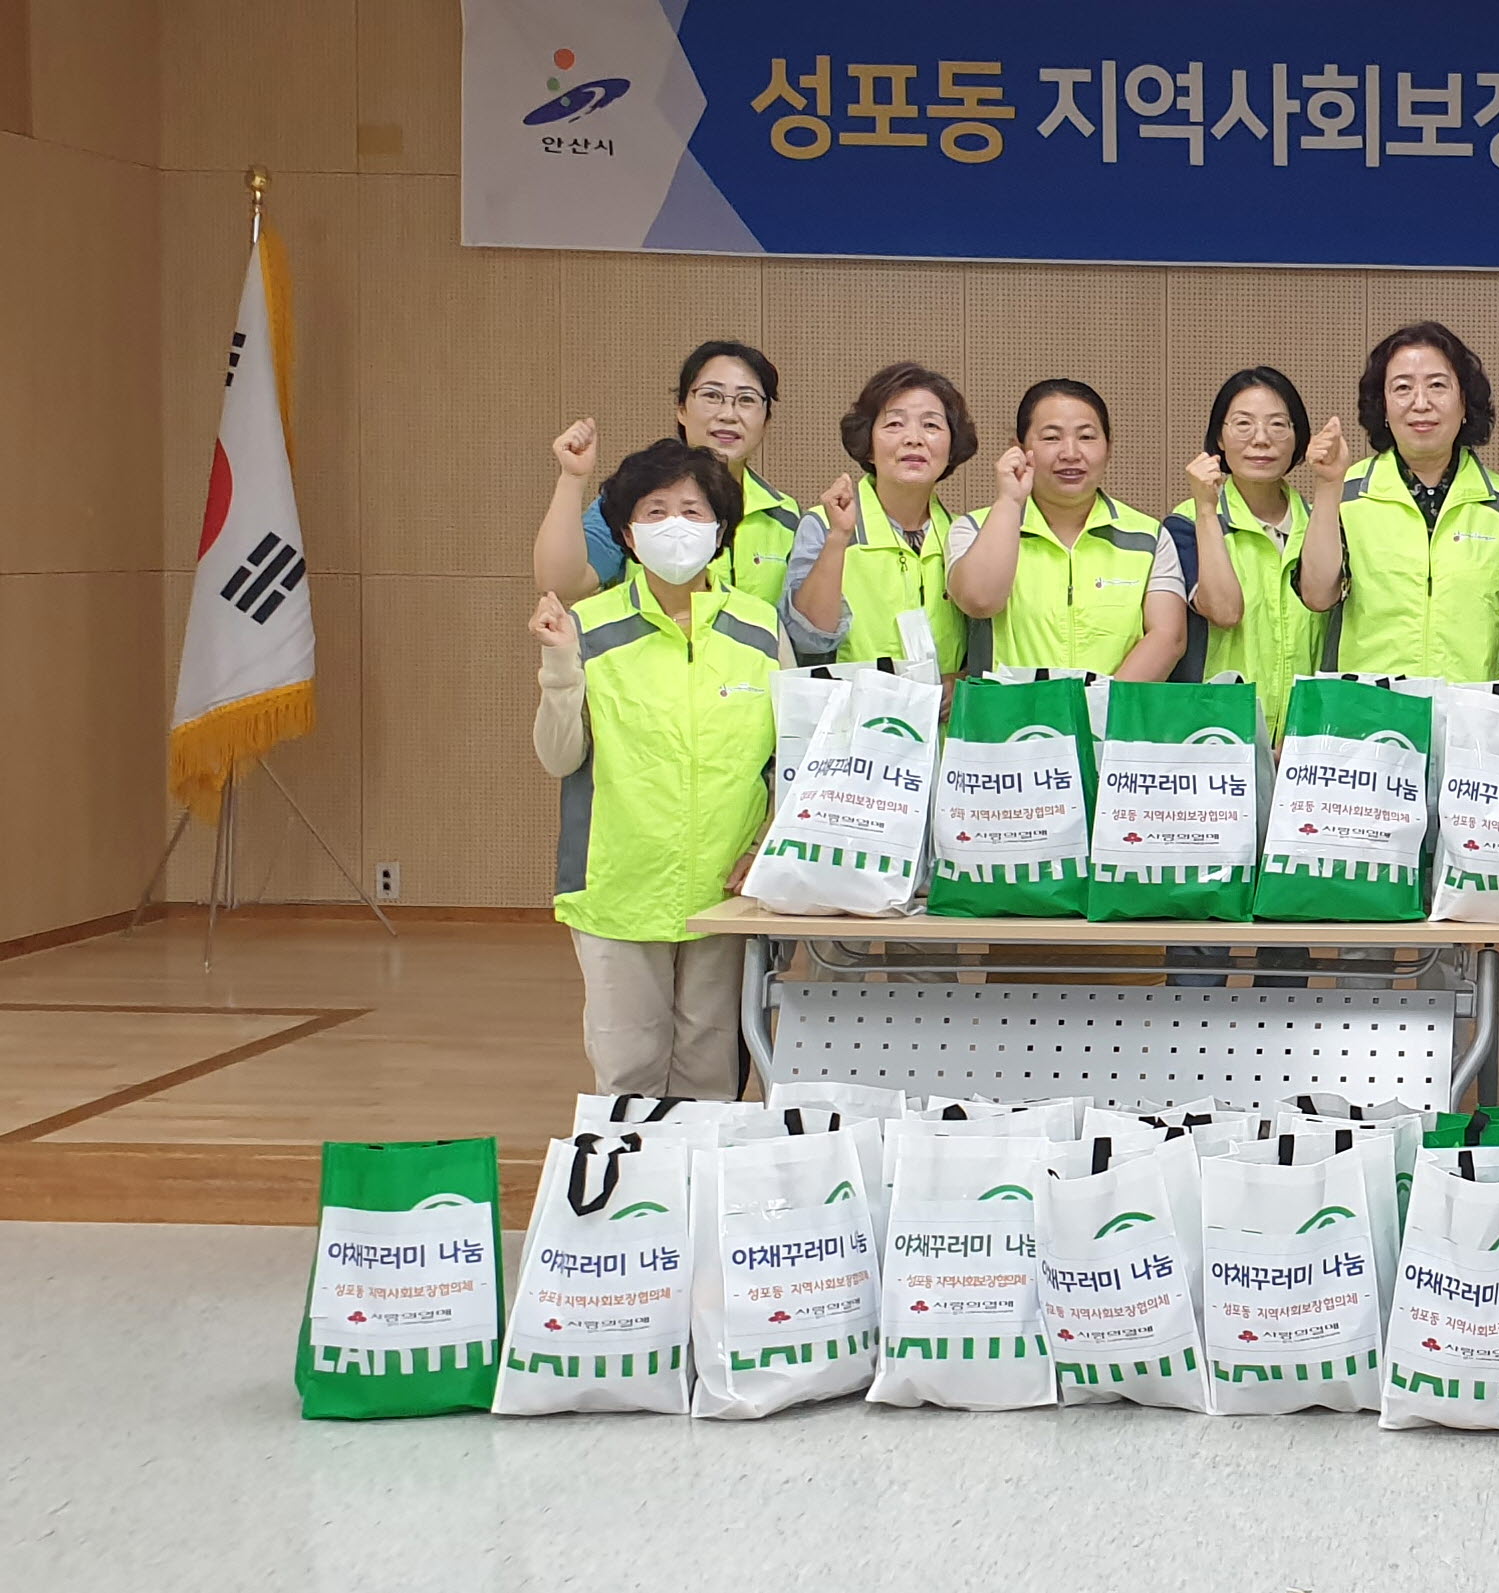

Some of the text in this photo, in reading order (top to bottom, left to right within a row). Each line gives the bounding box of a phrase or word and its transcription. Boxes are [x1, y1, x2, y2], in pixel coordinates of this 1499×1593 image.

[750, 54, 1015, 164] 성포동
[542, 136, 614, 156] 안산시
[807, 757, 872, 780] 야꾸러미
[883, 764, 923, 792] 나눔
[1034, 769, 1072, 789] 나눔
[1107, 772, 1247, 796] 야채꾸러미 나눔
[1286, 765, 1418, 801] 야채꾸러미 나눔
[970, 805, 1065, 820] 지역사회보장협의체
[1112, 809, 1238, 822] 성포동 지역사회보장협의체
[1290, 801, 1410, 823] 성포동 지역사회보장협의체
[1451, 815, 1477, 829] 성포동
[328, 1240, 484, 1270] 야채꾸러미 나눔
[732, 1236, 844, 1269] 야채꾸러미
[895, 1234, 991, 1258] 야채꾸러미
[639, 1246, 680, 1271] 나눔
[1131, 1254, 1173, 1281] 나눔
[907, 1275, 932, 1289] 성포동
[1212, 1252, 1365, 1291] 야채꾸러미 나눔
[335, 1280, 474, 1300] 성포동 지역사회보장협의체
[748, 1285, 783, 1301] 성포동
[1405, 1264, 1499, 1307] 야채꾸러미
[564, 1288, 671, 1308] 지역사회보장협의체
[1071, 1295, 1170, 1320] 지역사회보장협의체
[1223, 1293, 1358, 1319] 성포동 지역사회보장협의체
[1410, 1306, 1439, 1325] 성포동
